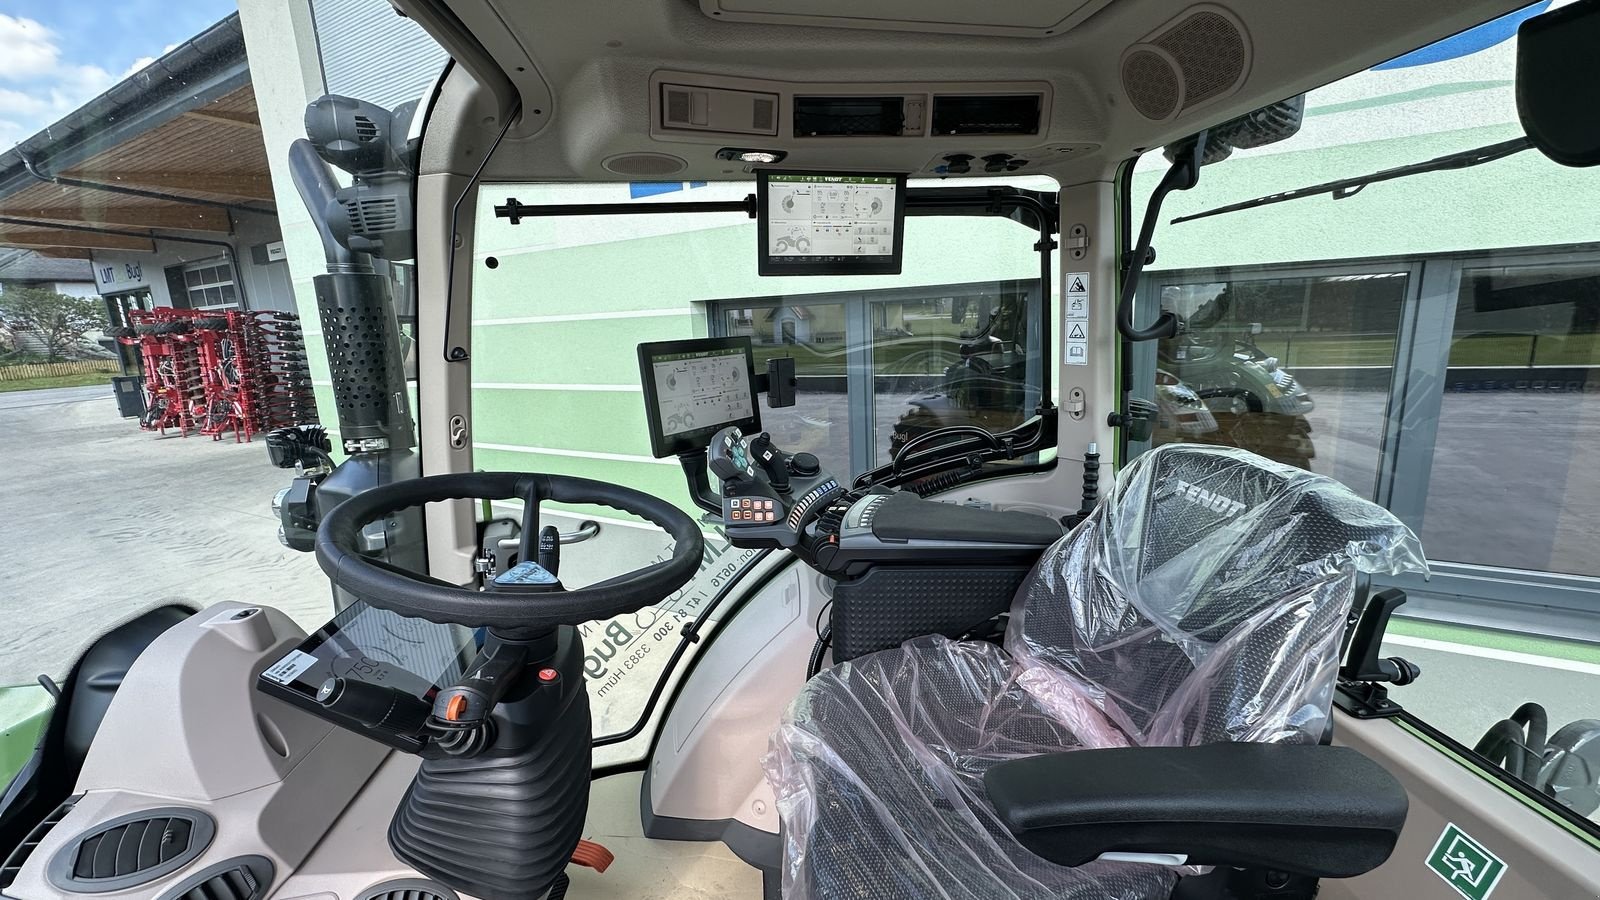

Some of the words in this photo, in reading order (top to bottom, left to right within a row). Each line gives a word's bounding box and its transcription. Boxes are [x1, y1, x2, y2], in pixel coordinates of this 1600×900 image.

[100, 268, 115, 283] LMT
[126, 261, 142, 282] Bugl
[892, 431, 909, 443] Bugl
[1176, 480, 1246, 517] FENDT
